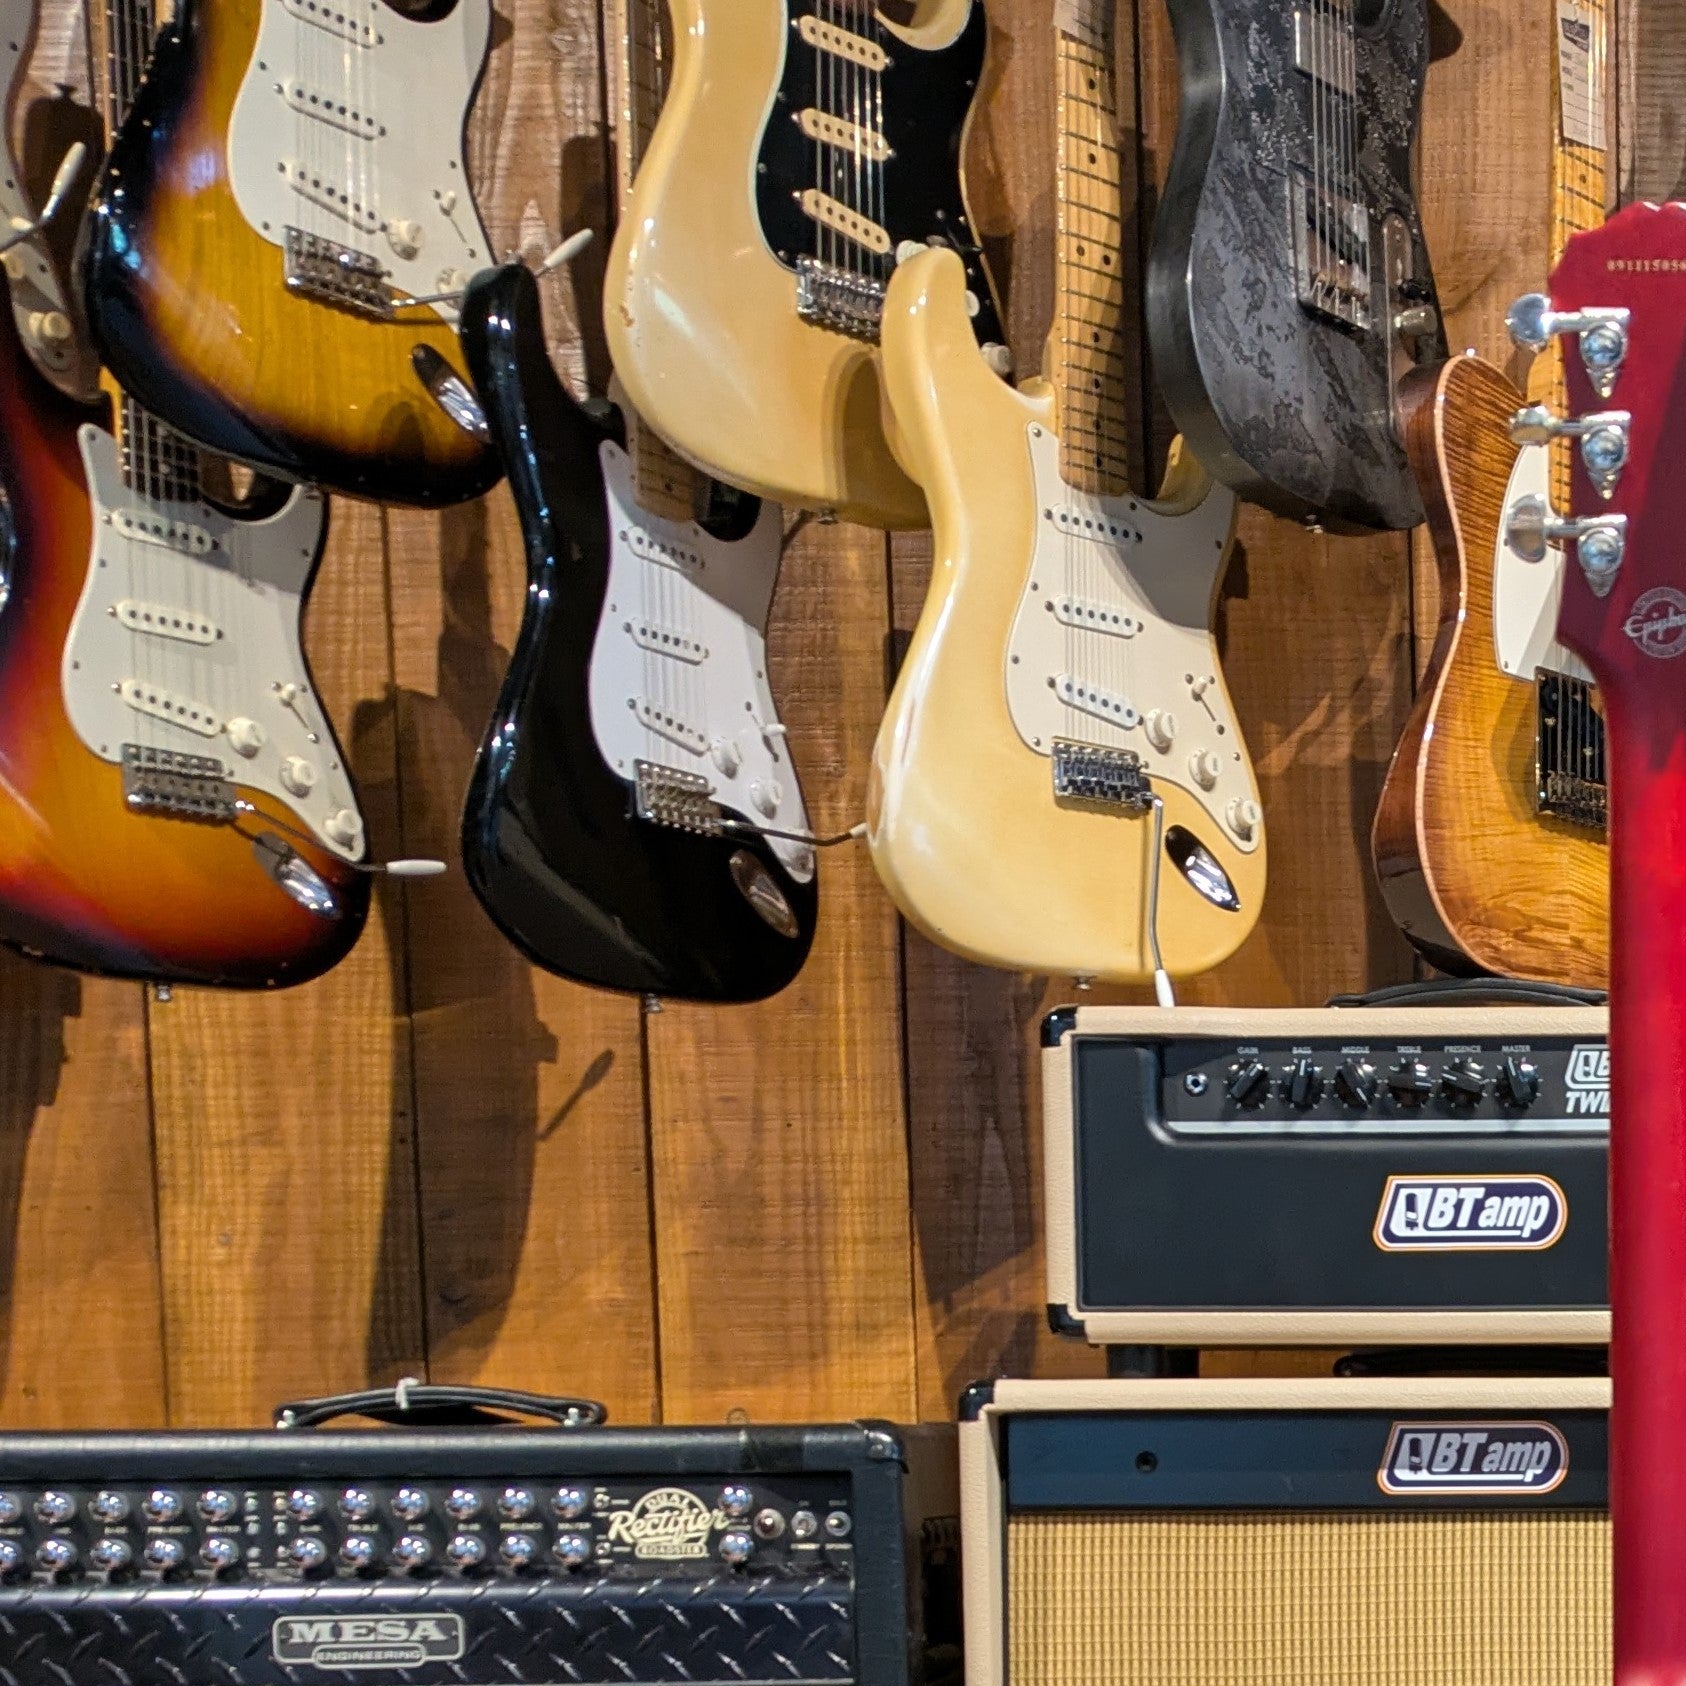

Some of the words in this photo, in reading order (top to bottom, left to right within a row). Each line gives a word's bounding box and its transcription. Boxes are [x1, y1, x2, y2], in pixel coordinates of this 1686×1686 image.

[645, 1493, 691, 1511] DUAL
[608, 1508, 730, 1547] Rectifier
[288, 1620, 447, 1643] MESA
[316, 1650, 421, 1662] ENGINEERING
